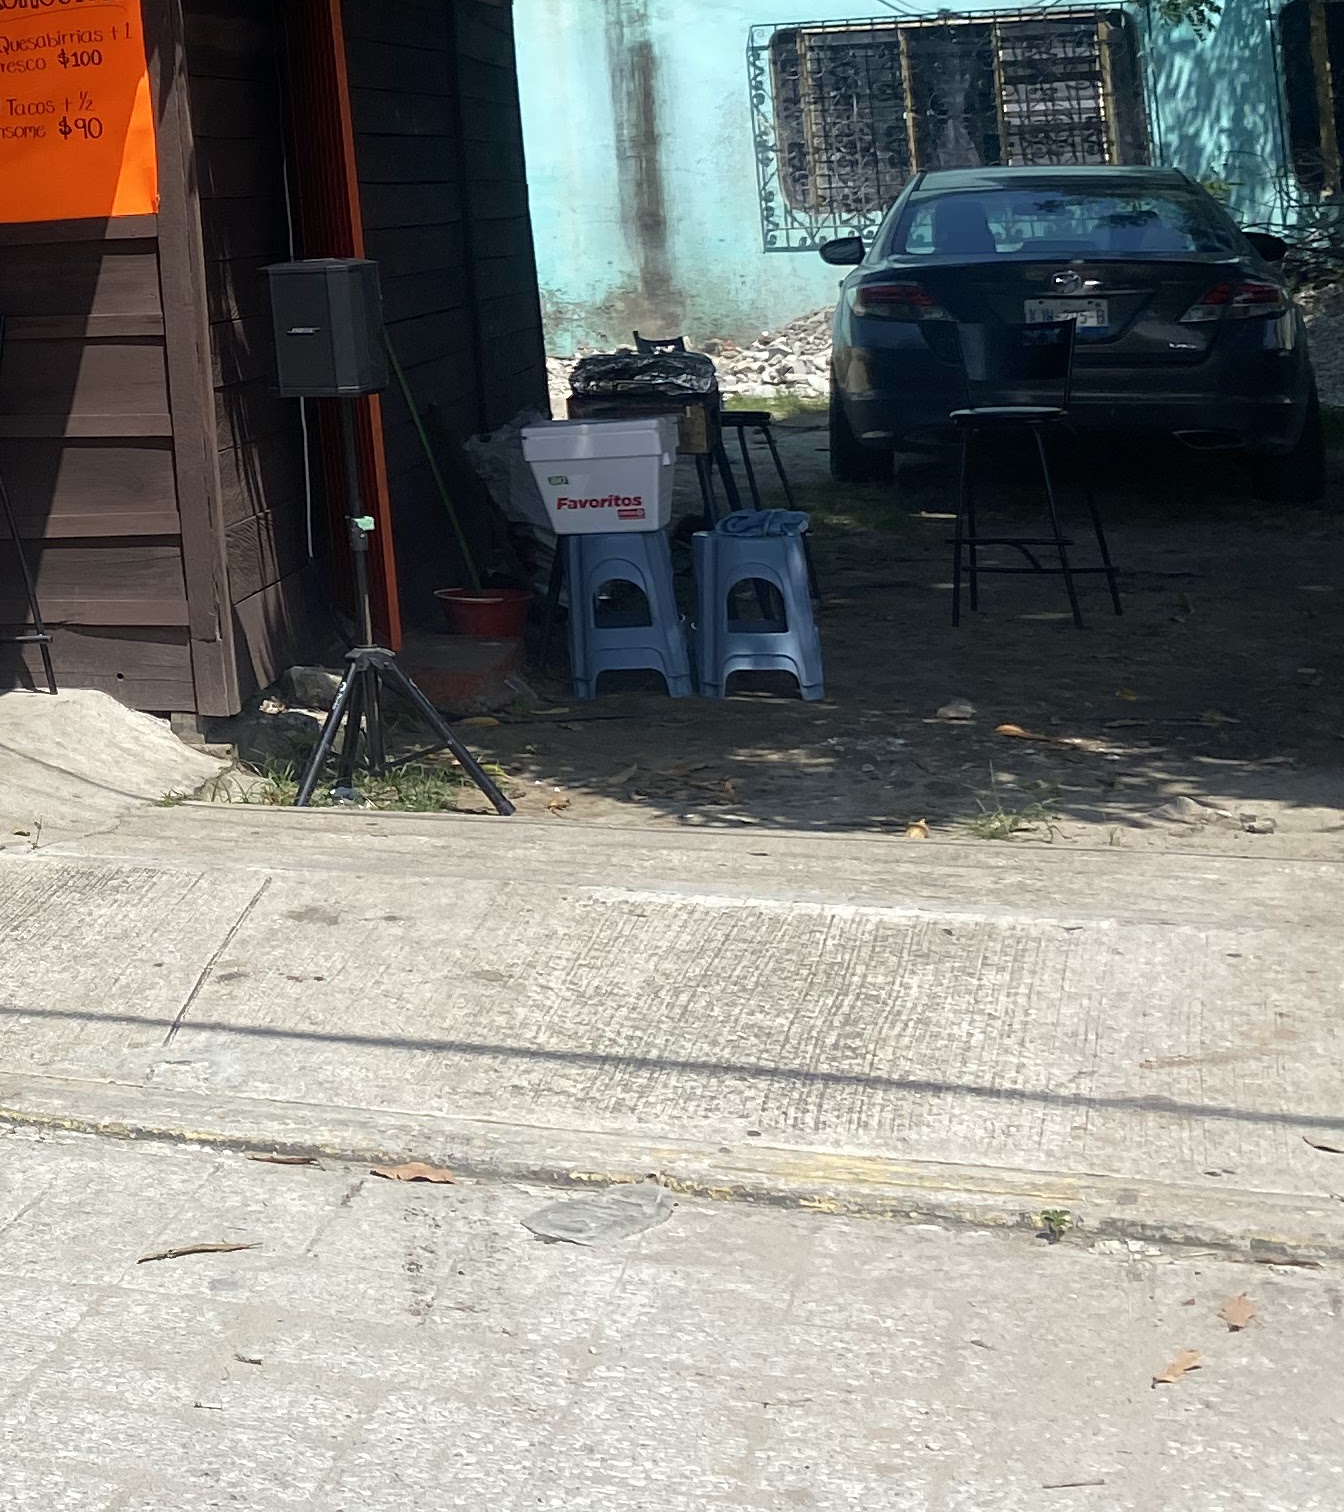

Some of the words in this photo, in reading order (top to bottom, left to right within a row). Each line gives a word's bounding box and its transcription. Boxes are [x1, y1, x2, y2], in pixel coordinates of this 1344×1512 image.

[57, 48, 103, 69] $100
[6, 97, 56, 116] Tacos
[58, 116, 104, 141] $90
[557, 494, 642, 510] Favoritos
